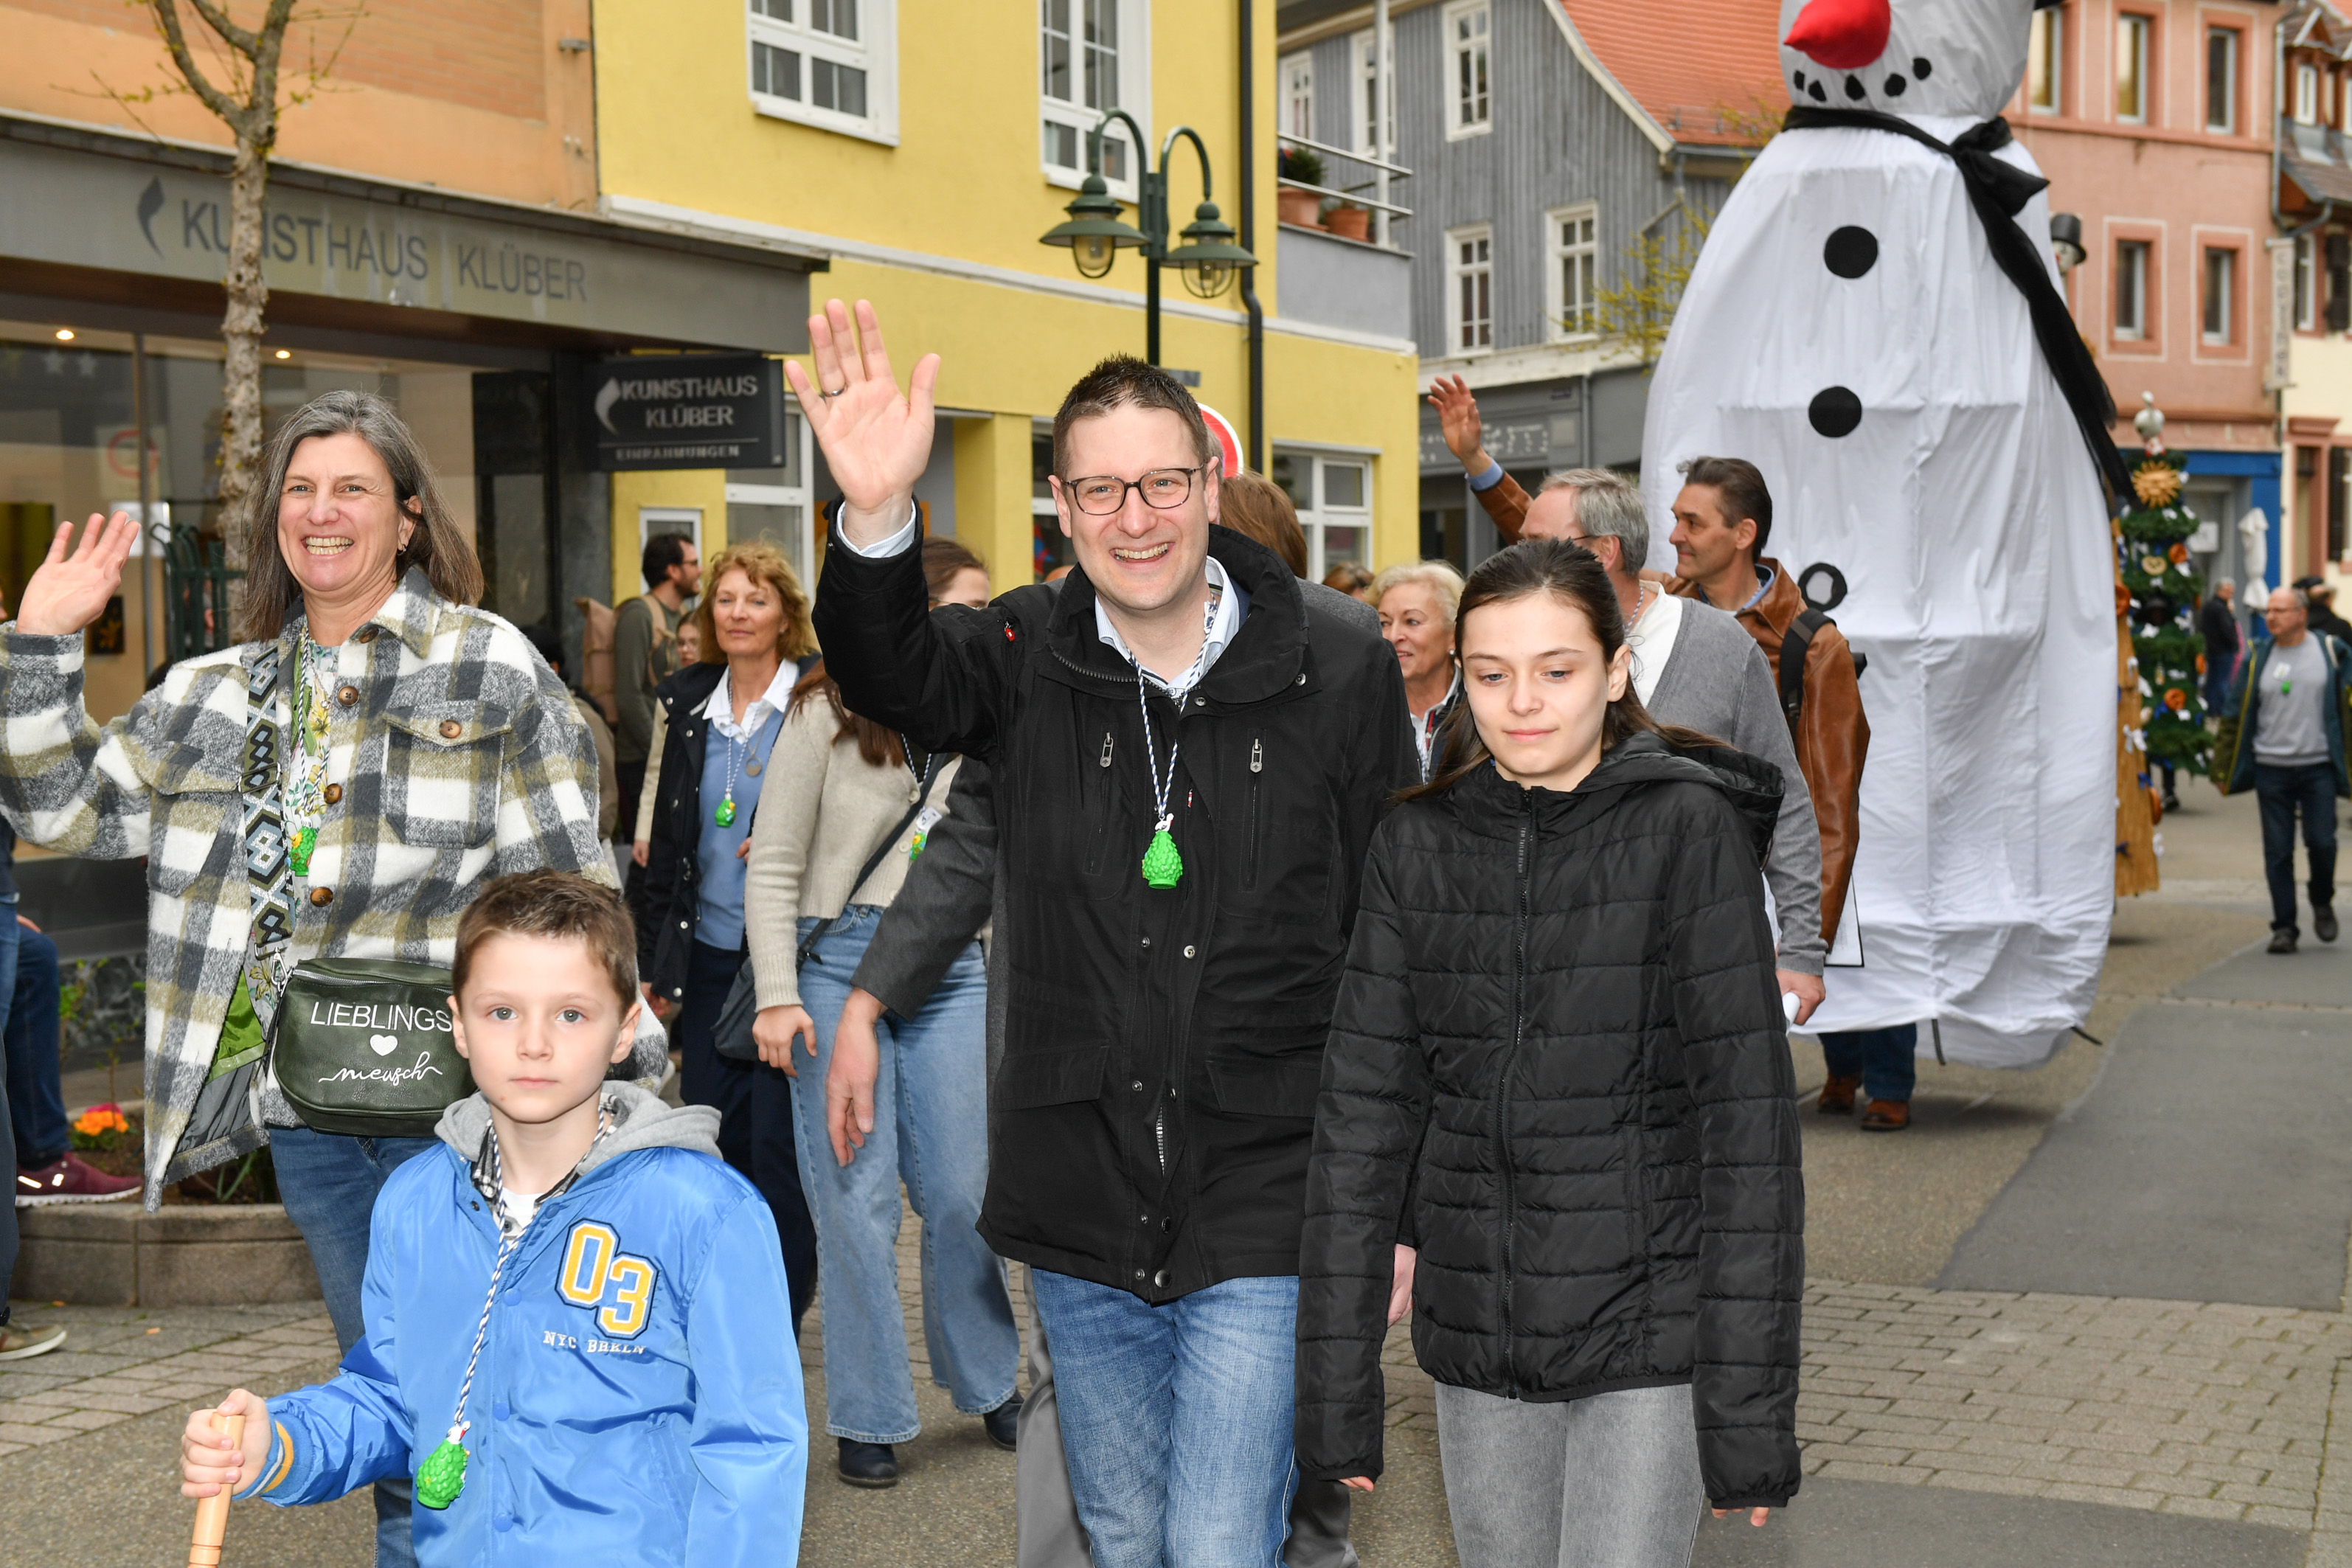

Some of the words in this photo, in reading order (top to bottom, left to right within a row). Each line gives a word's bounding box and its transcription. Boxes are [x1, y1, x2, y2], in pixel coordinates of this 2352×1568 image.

[457, 242, 588, 302] KLÜBER
[622, 375, 758, 400] KUNSTHAUS
[645, 403, 734, 429] KLÜBER
[310, 1001, 453, 1033] LIEBLINGS
[559, 1222, 655, 1336] 03
[542, 1330, 577, 1350] NYC
